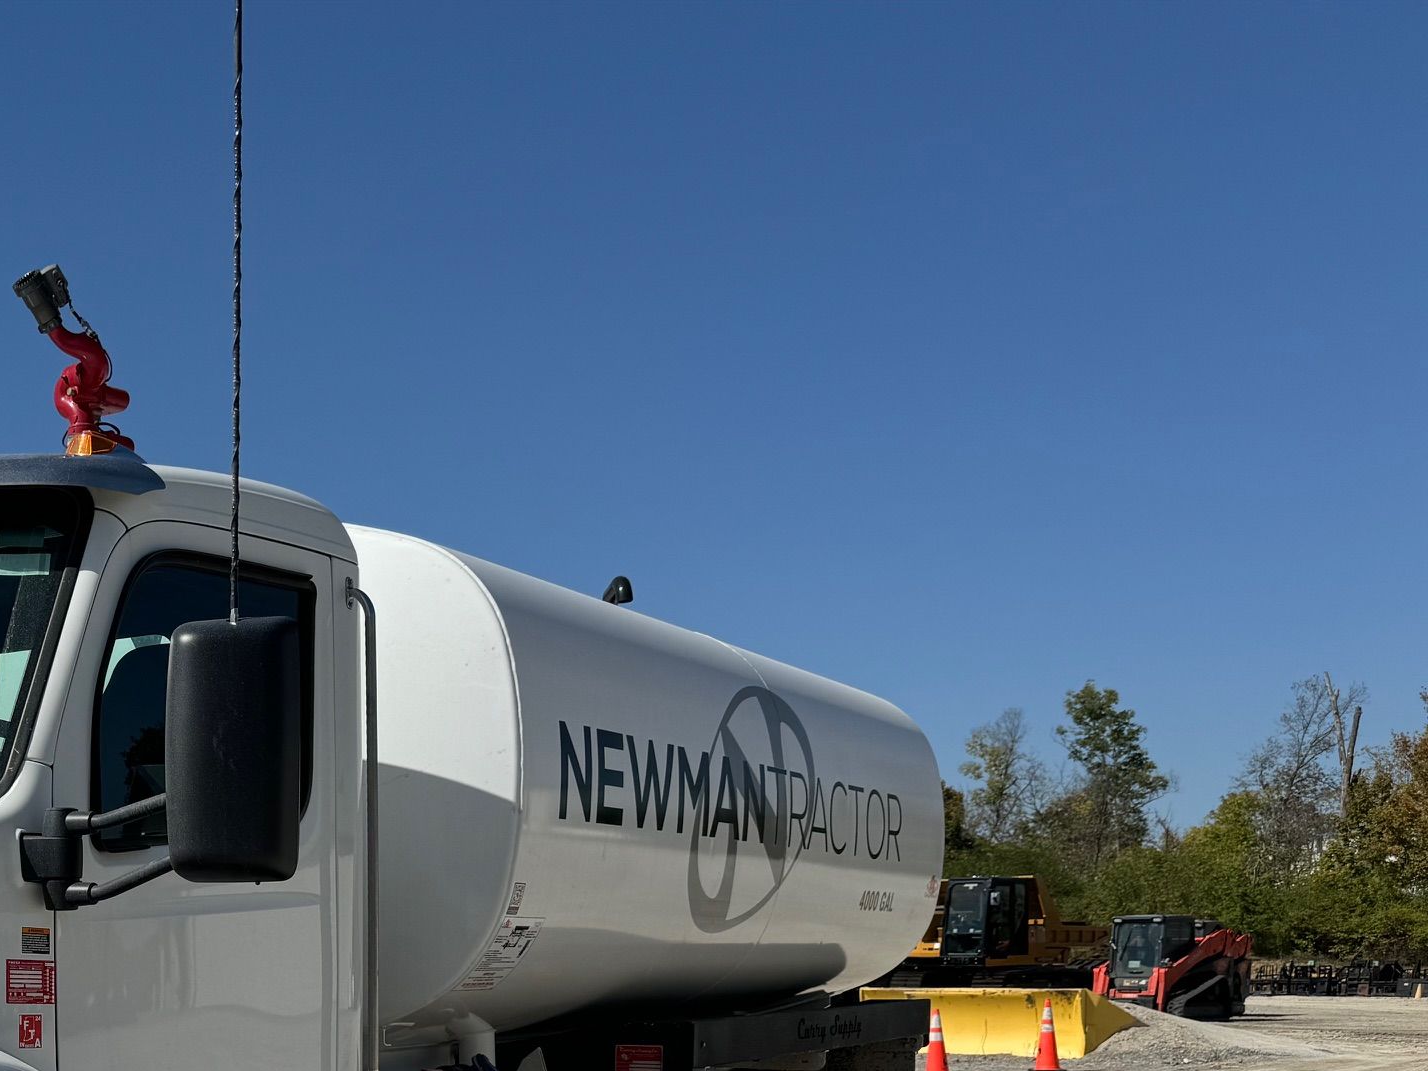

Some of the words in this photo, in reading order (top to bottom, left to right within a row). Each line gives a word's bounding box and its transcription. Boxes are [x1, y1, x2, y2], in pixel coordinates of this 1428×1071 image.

[859, 890, 881, 911] 4000
[879, 891, 895, 912] GAL
[829, 1014, 863, 1040] Supply
